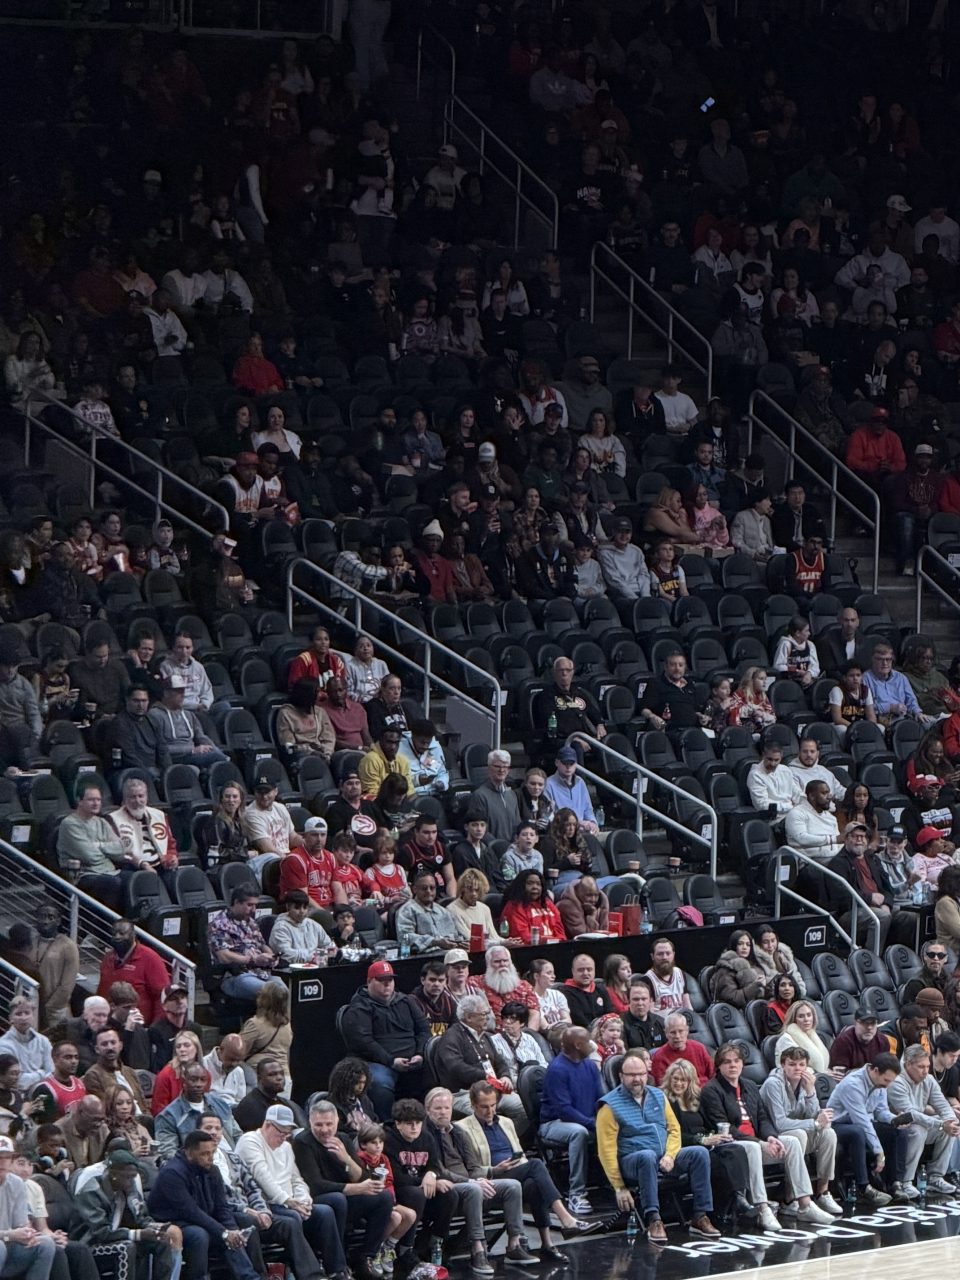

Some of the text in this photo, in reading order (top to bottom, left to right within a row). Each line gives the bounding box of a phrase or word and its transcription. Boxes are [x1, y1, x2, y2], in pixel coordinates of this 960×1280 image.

[809, 931, 822, 942] 109
[304, 985, 319, 996] 109
[668, 1222, 876, 1259] Power
